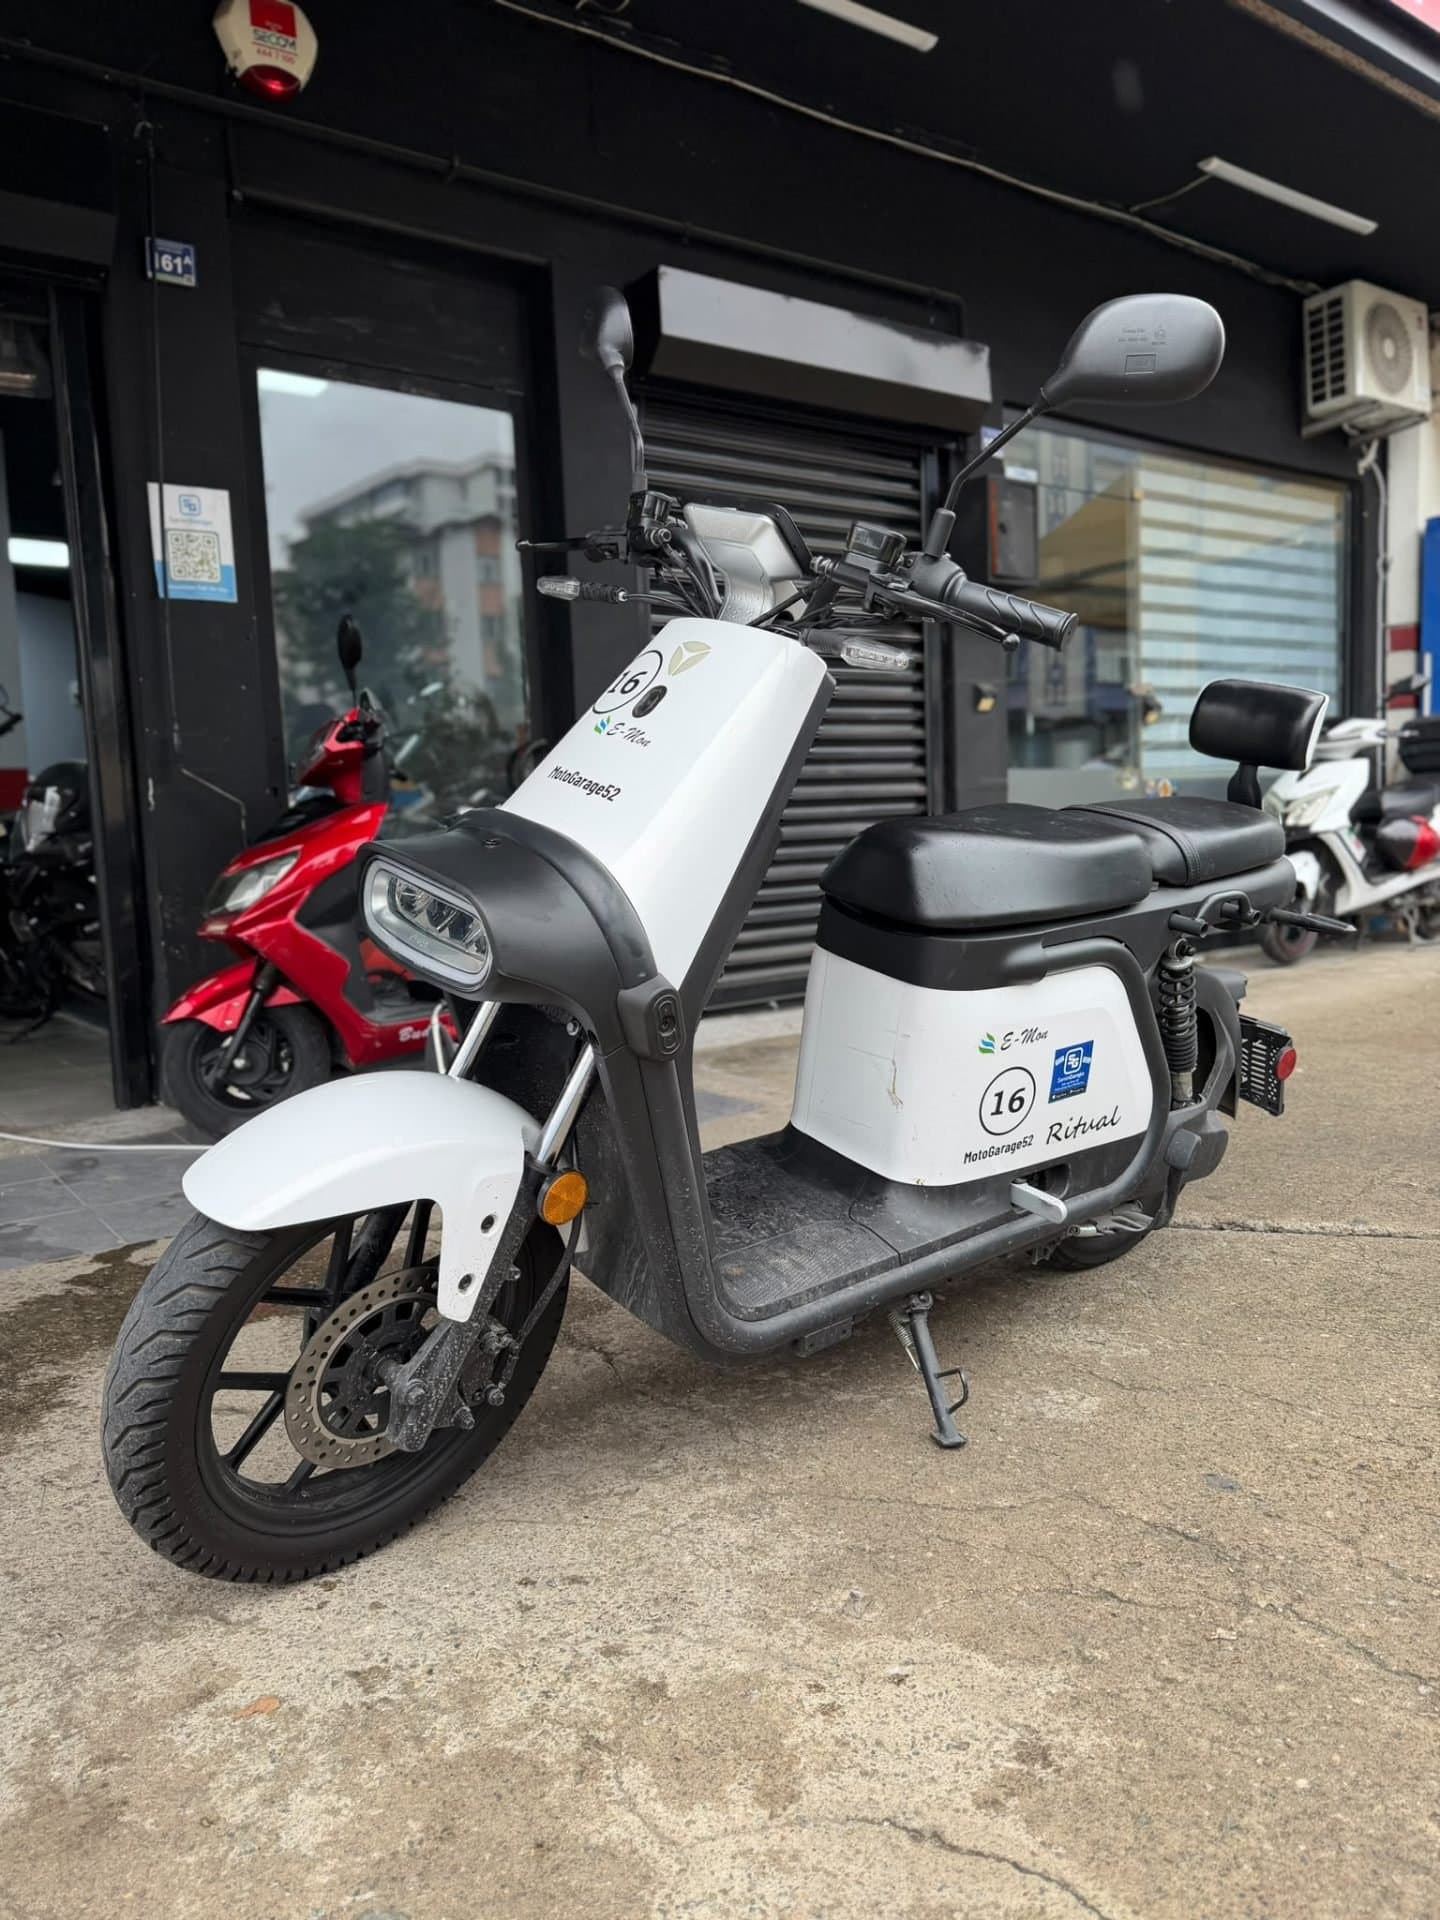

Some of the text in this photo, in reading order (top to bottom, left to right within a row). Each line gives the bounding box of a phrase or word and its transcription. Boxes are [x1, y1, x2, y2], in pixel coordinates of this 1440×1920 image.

[253, 29, 297, 52] SECOM
[607, 670, 648, 695] 16
[606, 722, 651, 747] E-Mon
[549, 765, 621, 801] MotoGarage52
[1001, 1027, 1049, 1051] E-Mon
[990, 1087, 1026, 1116] 16
[1046, 1105, 1122, 1145] Ritual
[963, 1134, 1034, 1164] MotoGarage52
